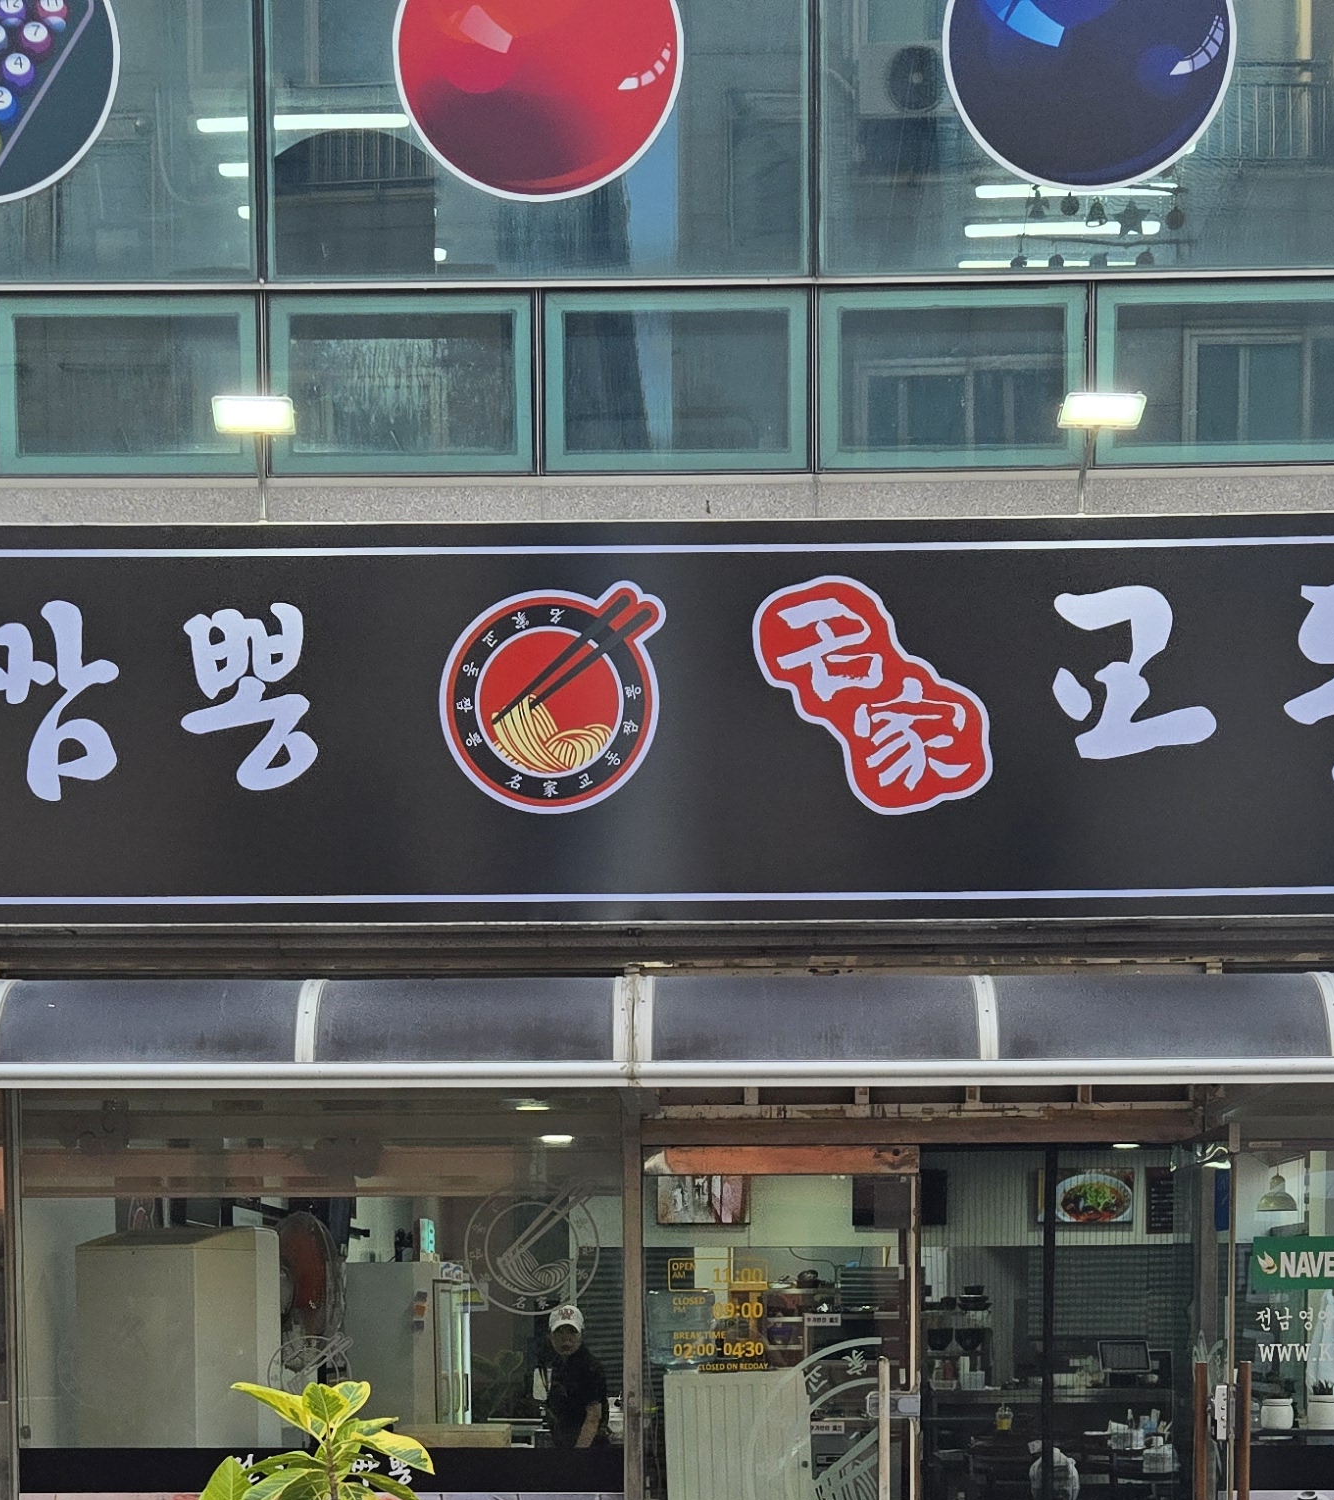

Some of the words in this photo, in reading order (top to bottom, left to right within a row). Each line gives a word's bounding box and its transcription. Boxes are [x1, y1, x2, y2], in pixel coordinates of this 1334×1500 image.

[31, 24, 41, 37] 7
[13, 56, 24, 69] 4
[672, 1262, 696, 1271] OPEN
[672, 1271, 686, 1279] AM
[712, 1267, 763, 1283] 11:00
[672, 1296, 706, 1305] CLOSED
[712, 1302, 764, 1319] 09:00
[1254, 1306, 1294, 1332] 전남
[673, 1331, 701, 1340] BREAK
[704, 1331, 727, 1339] TIME
[698, 1363, 724, 1371] CLOSED
